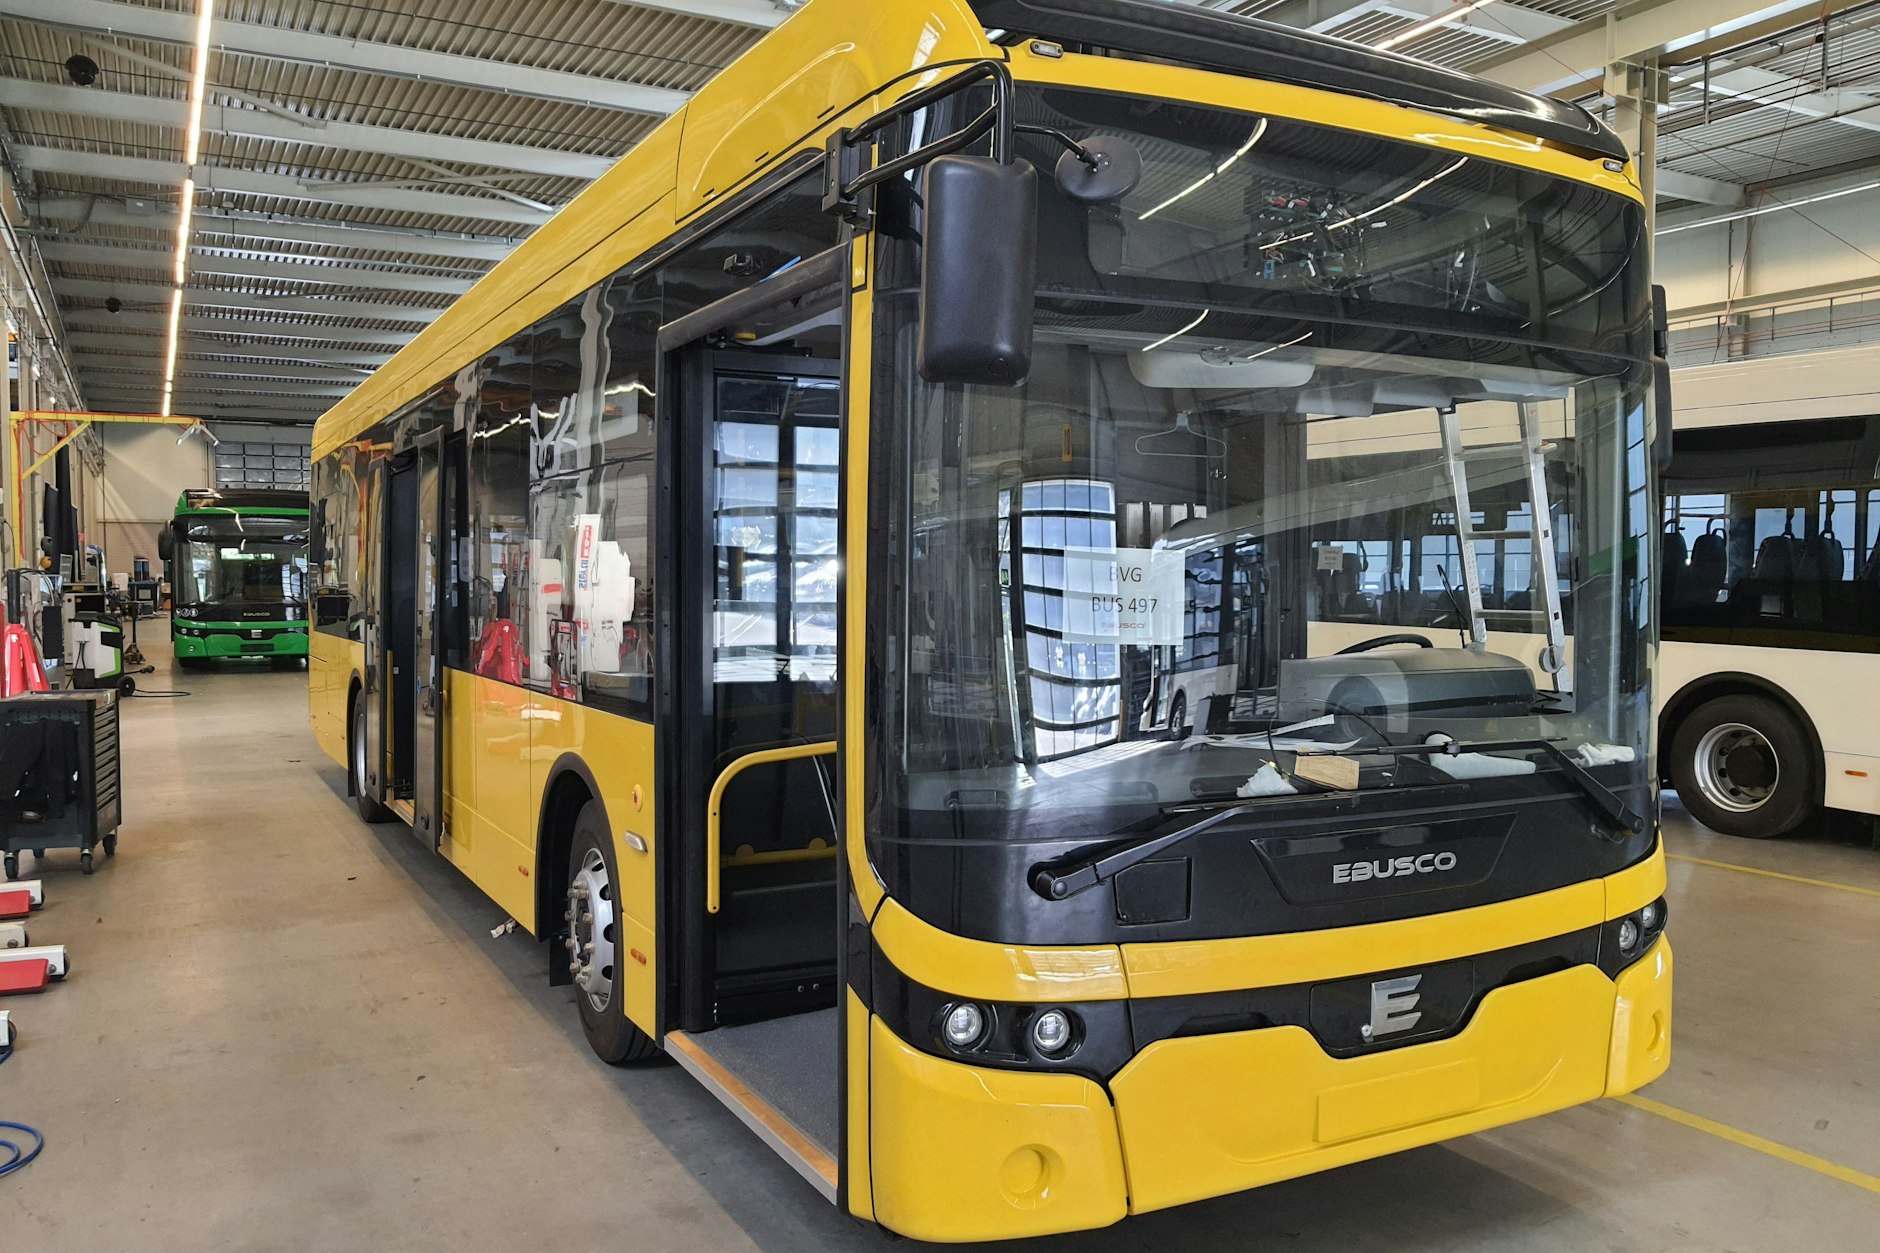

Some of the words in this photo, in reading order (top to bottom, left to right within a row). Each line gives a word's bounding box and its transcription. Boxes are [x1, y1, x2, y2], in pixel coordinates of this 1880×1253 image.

[1109, 566, 1142, 583] BVG
[1091, 596, 1124, 613] BUS
[1128, 597, 1158, 614] 497
[1333, 851, 1457, 884] EBUSCO
[1370, 973, 1423, 1037] E
